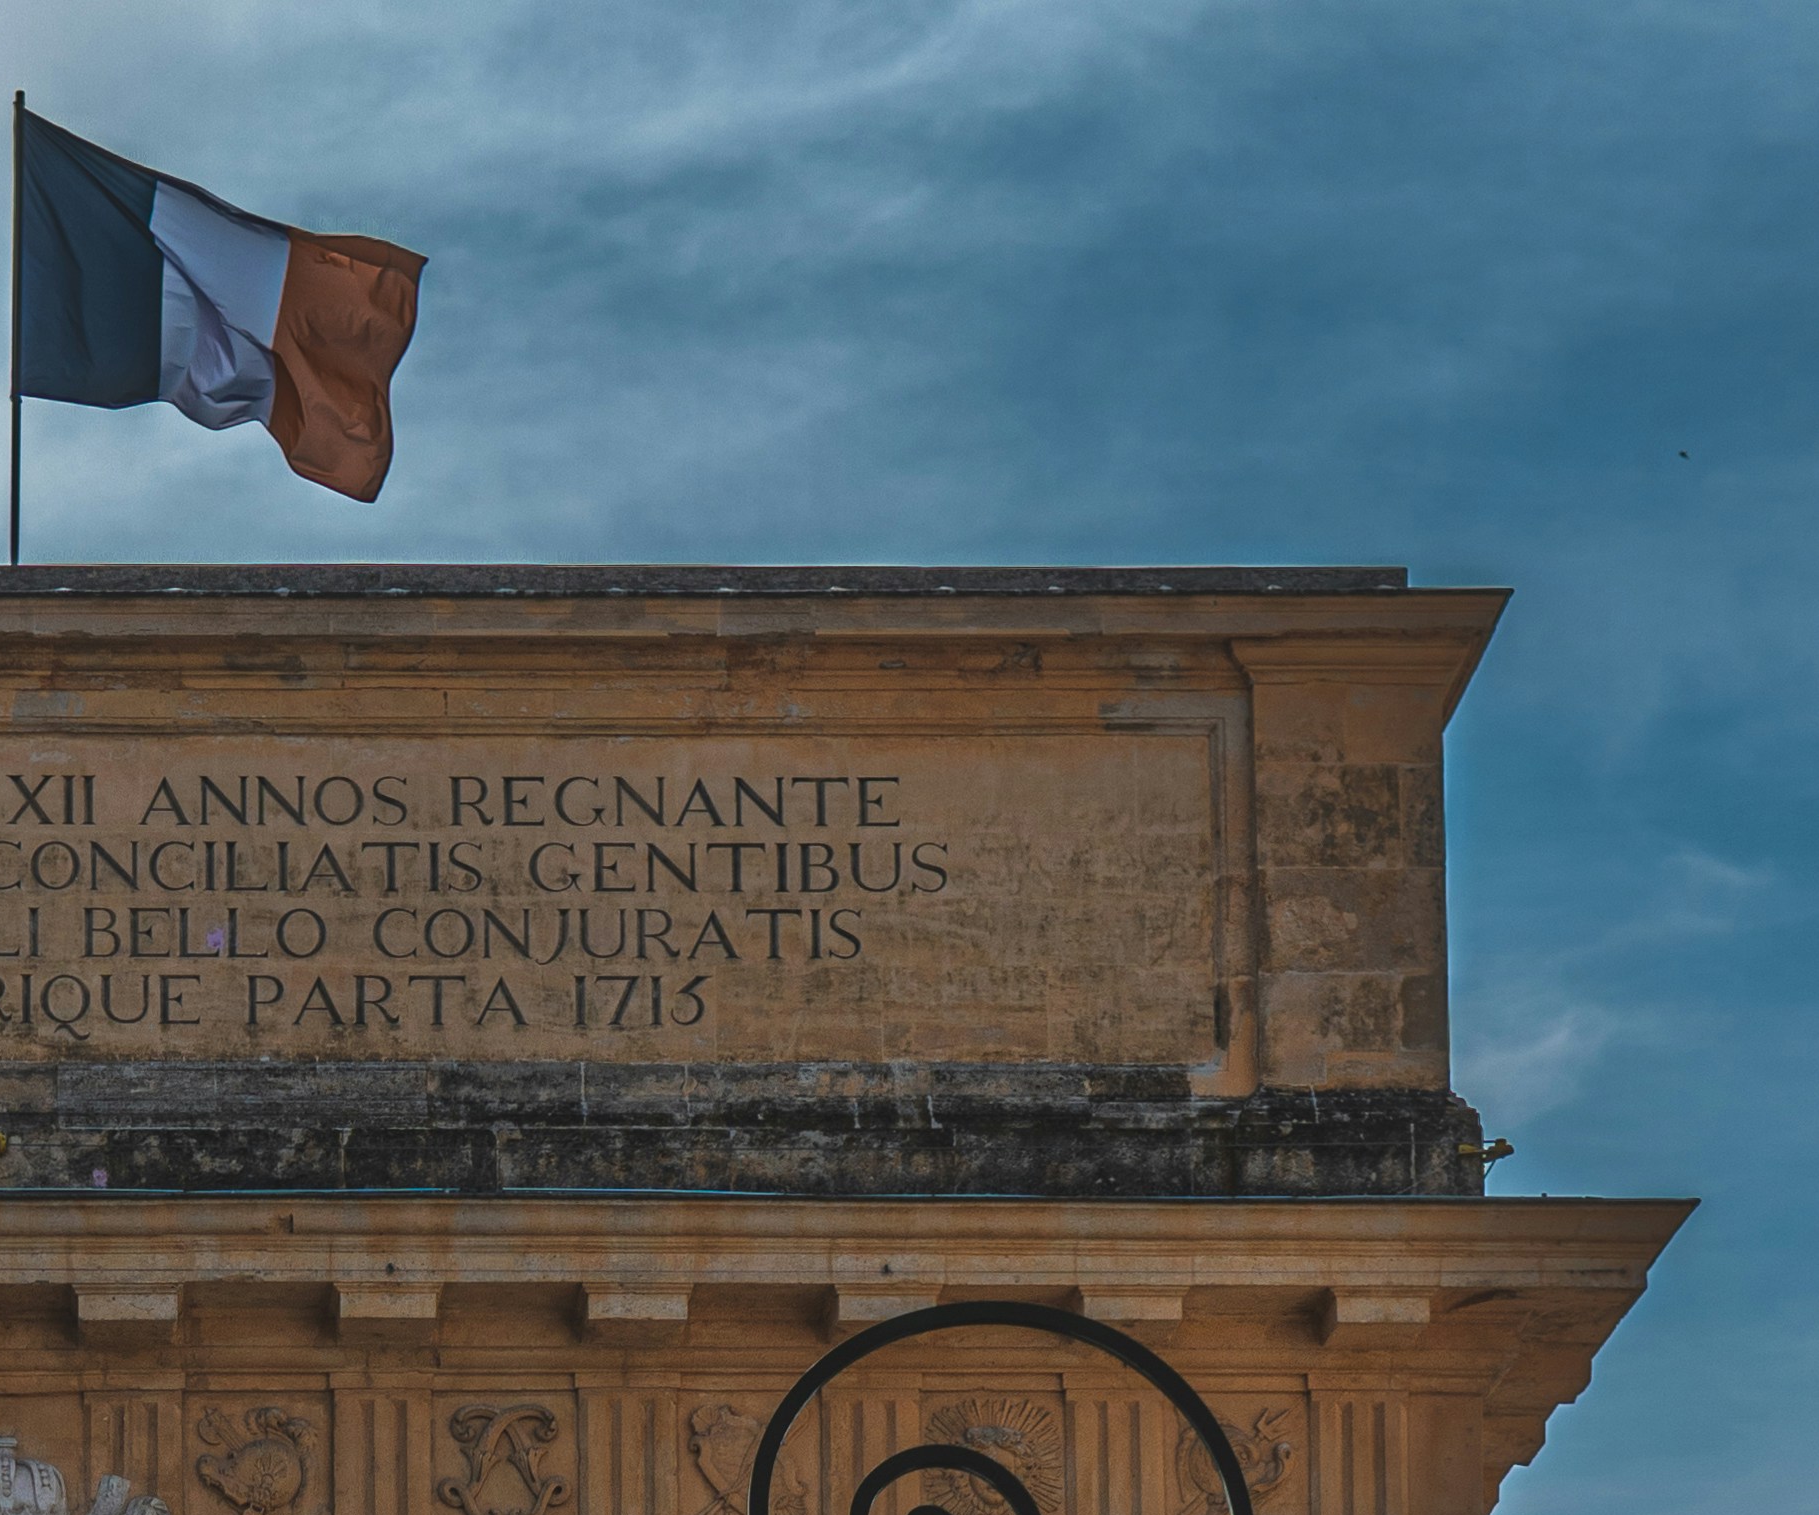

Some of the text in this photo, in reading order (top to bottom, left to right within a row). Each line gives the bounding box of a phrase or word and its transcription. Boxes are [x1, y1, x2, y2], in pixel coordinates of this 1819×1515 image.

[138, 775, 408, 827] ANNOS
[448, 776, 901, 827] REGNANTE
[528, 842, 949, 893] GENTIBUS
[82, 907, 327, 958] BELLO
[372, 908, 863, 965] CONJURATIS
[246, 975, 529, 1026] PARTA
[574, 975, 713, 1027] 1715
